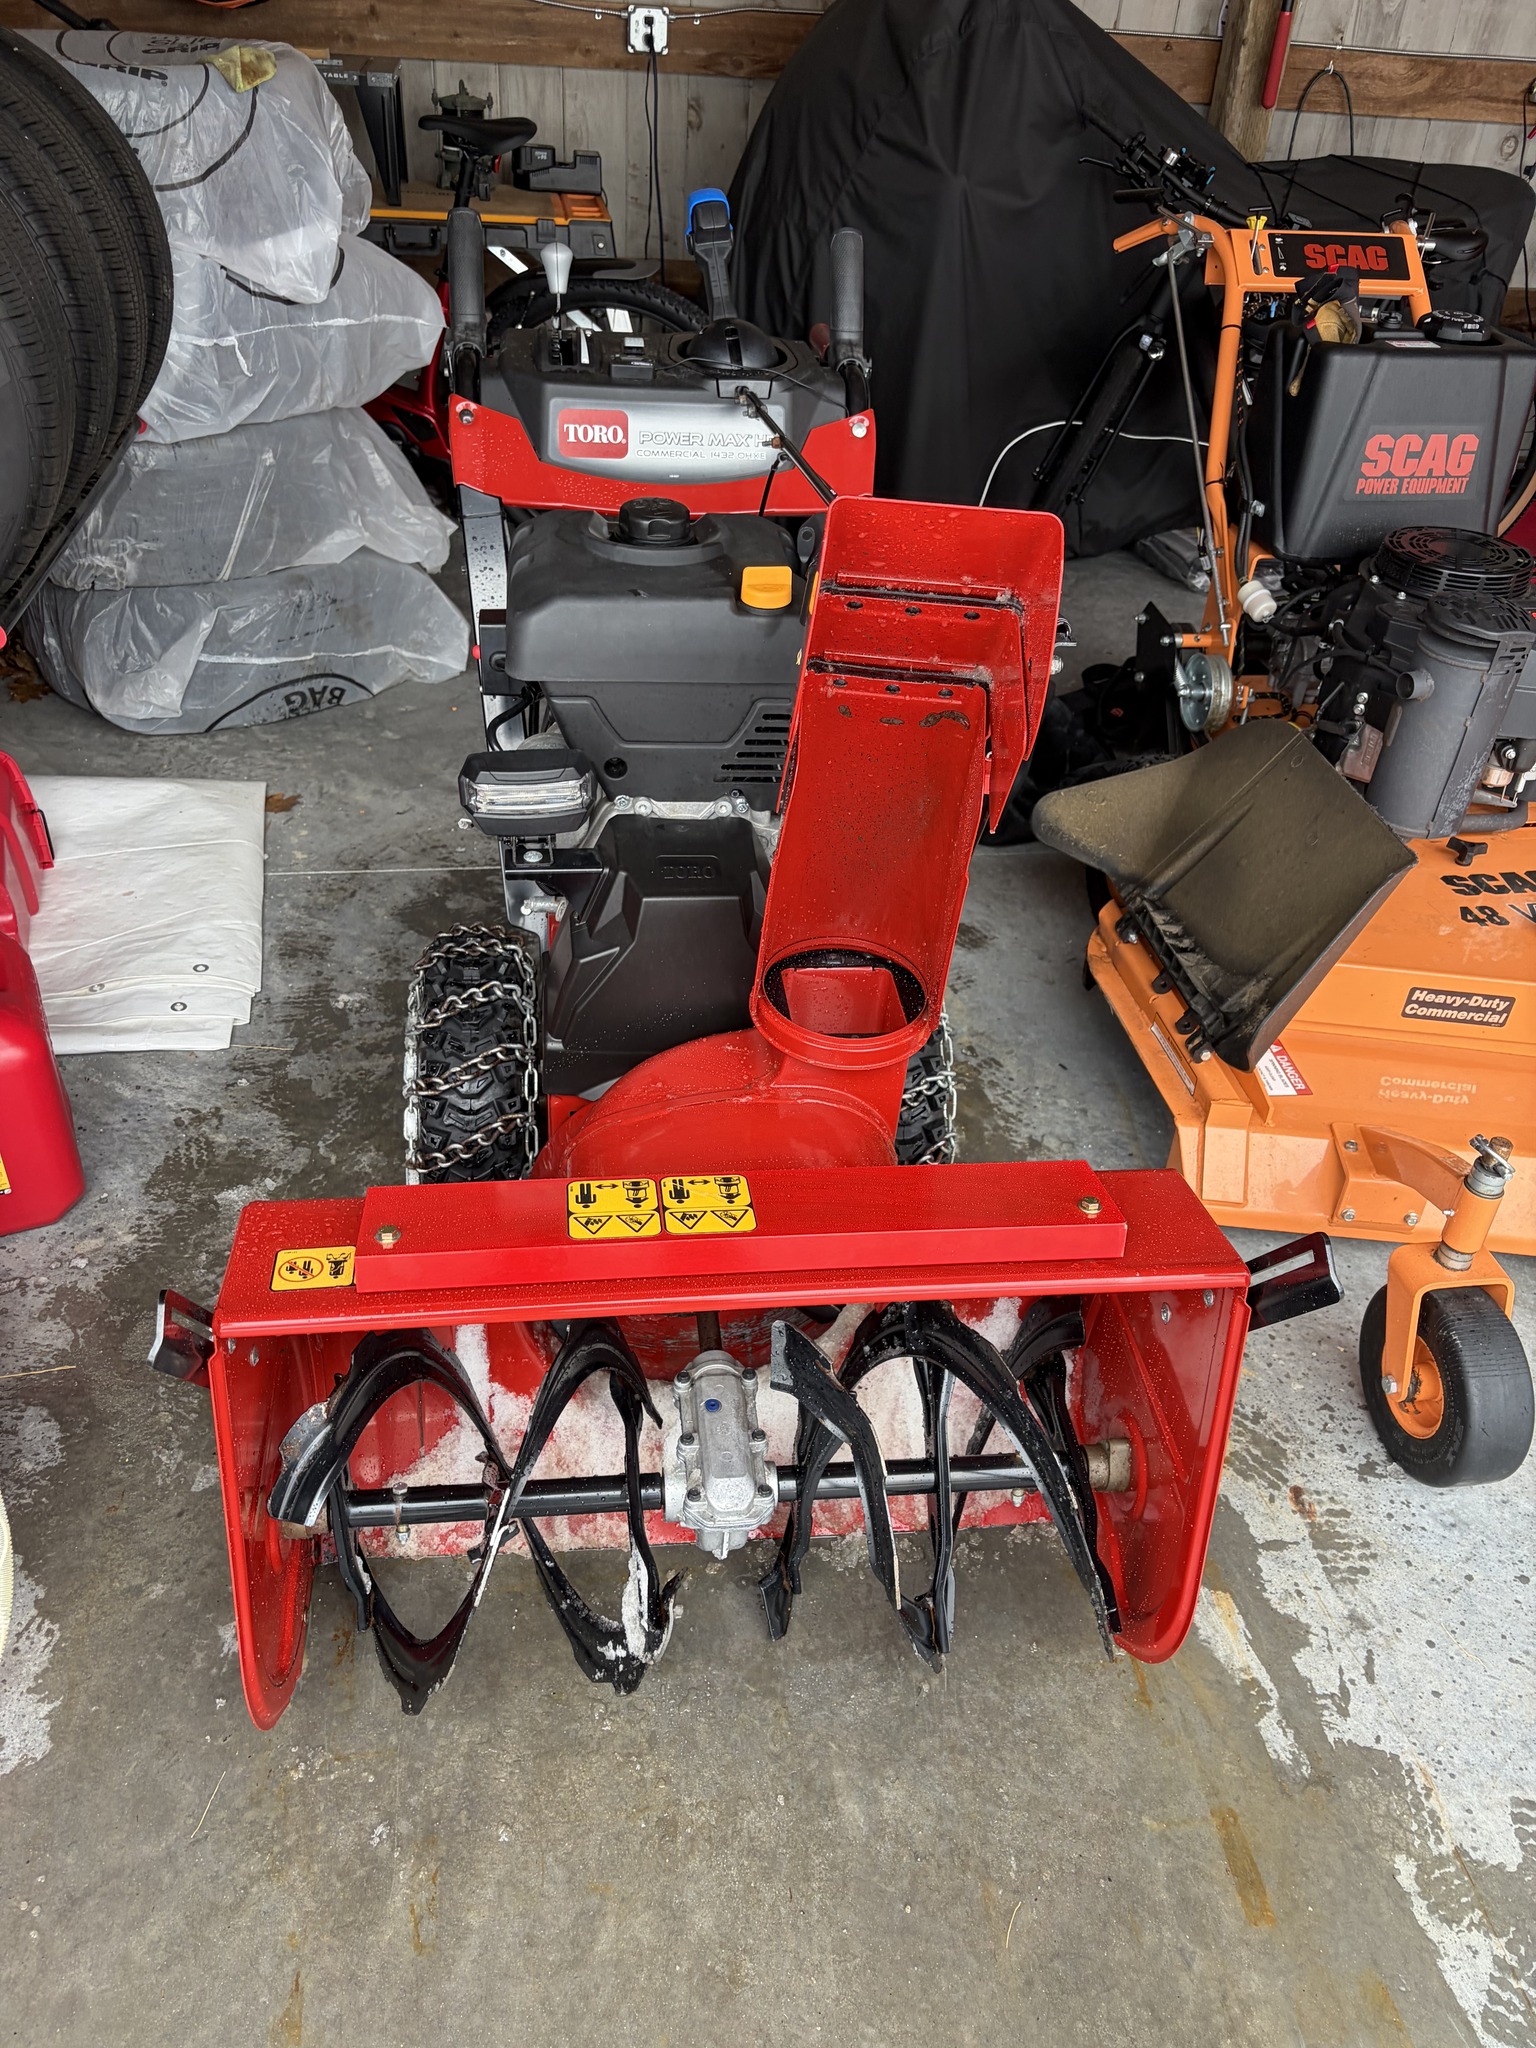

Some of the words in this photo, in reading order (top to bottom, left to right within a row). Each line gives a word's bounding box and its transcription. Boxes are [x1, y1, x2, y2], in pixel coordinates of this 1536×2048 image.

[1303, 243, 1389, 271] SCAG
[564, 424, 623, 444] TORO
[639, 431, 704, 447] POWER
[636, 449, 705, 458] COMMERCIAL
[709, 450, 735, 460] 1432
[1360, 434, 1480, 477] SCAG
[1355, 478, 1399, 495] POWER
[1400, 477, 1469, 495] EQUIPMENT
[1459, 905, 1510, 926] 48
[1411, 989, 1510, 1012] Heavy-Duty
[1404, 1003, 1508, 1024] Commercial
[1276, 1055, 1306, 1090] DANGER
